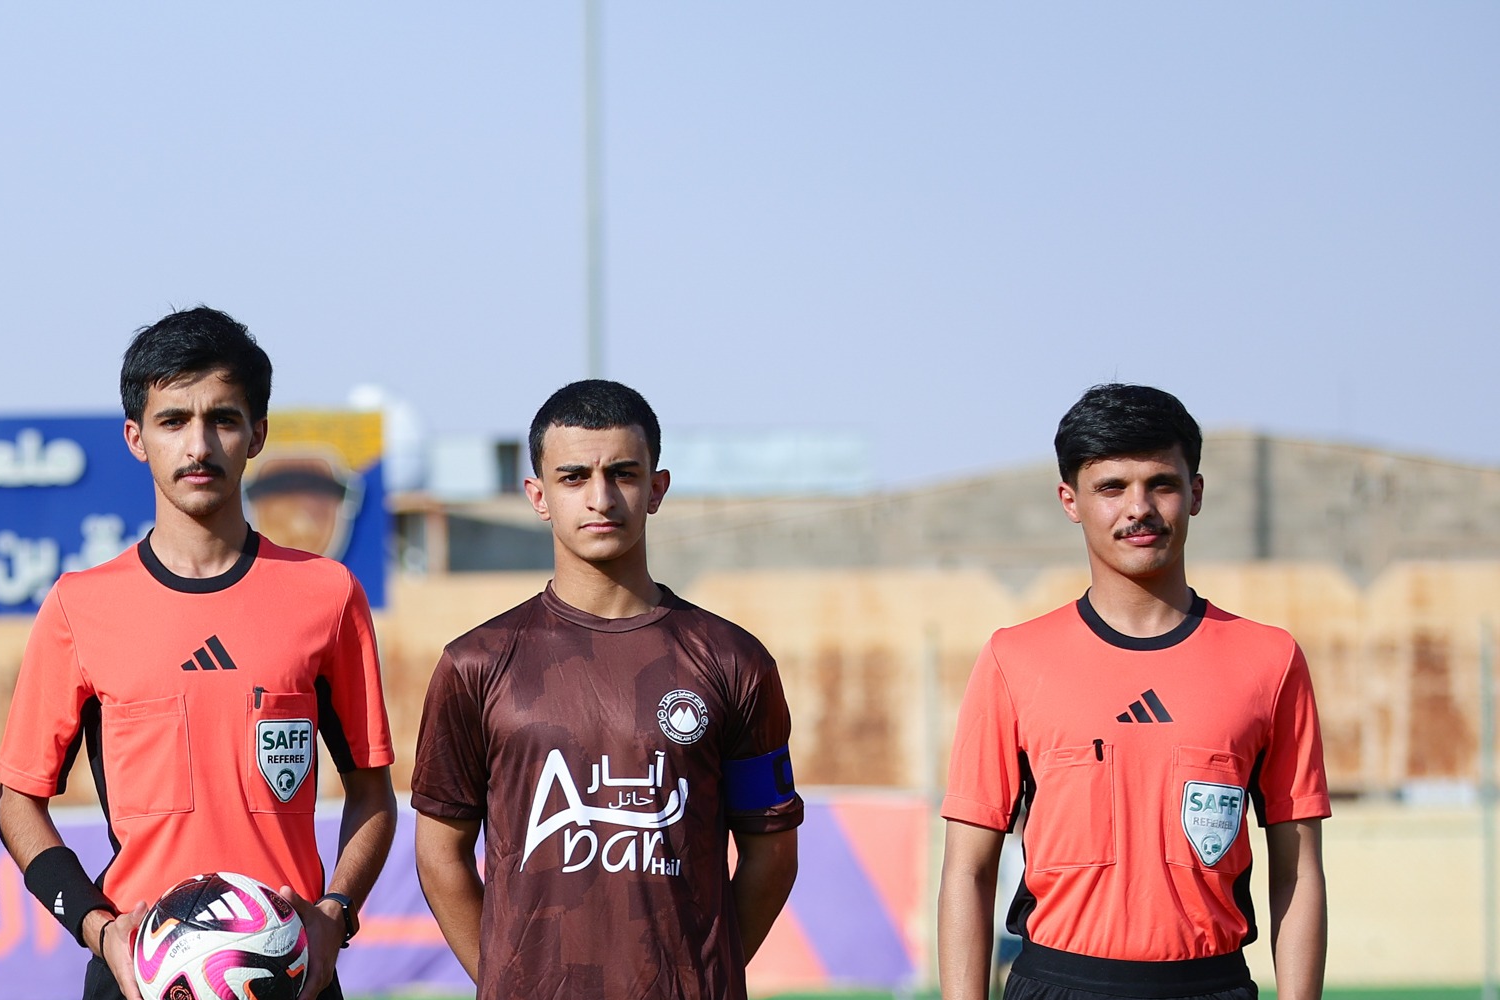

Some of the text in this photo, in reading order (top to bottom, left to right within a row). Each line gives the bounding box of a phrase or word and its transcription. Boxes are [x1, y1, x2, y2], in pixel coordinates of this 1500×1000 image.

[261, 729, 309, 751] SAFF
[267, 754, 305, 765] REFEREE
[587, 750, 666, 795] آبار
[607, 790, 655, 810] حائل
[1189, 791, 1240, 816] SAFF
[650, 857, 681, 877] Hail
